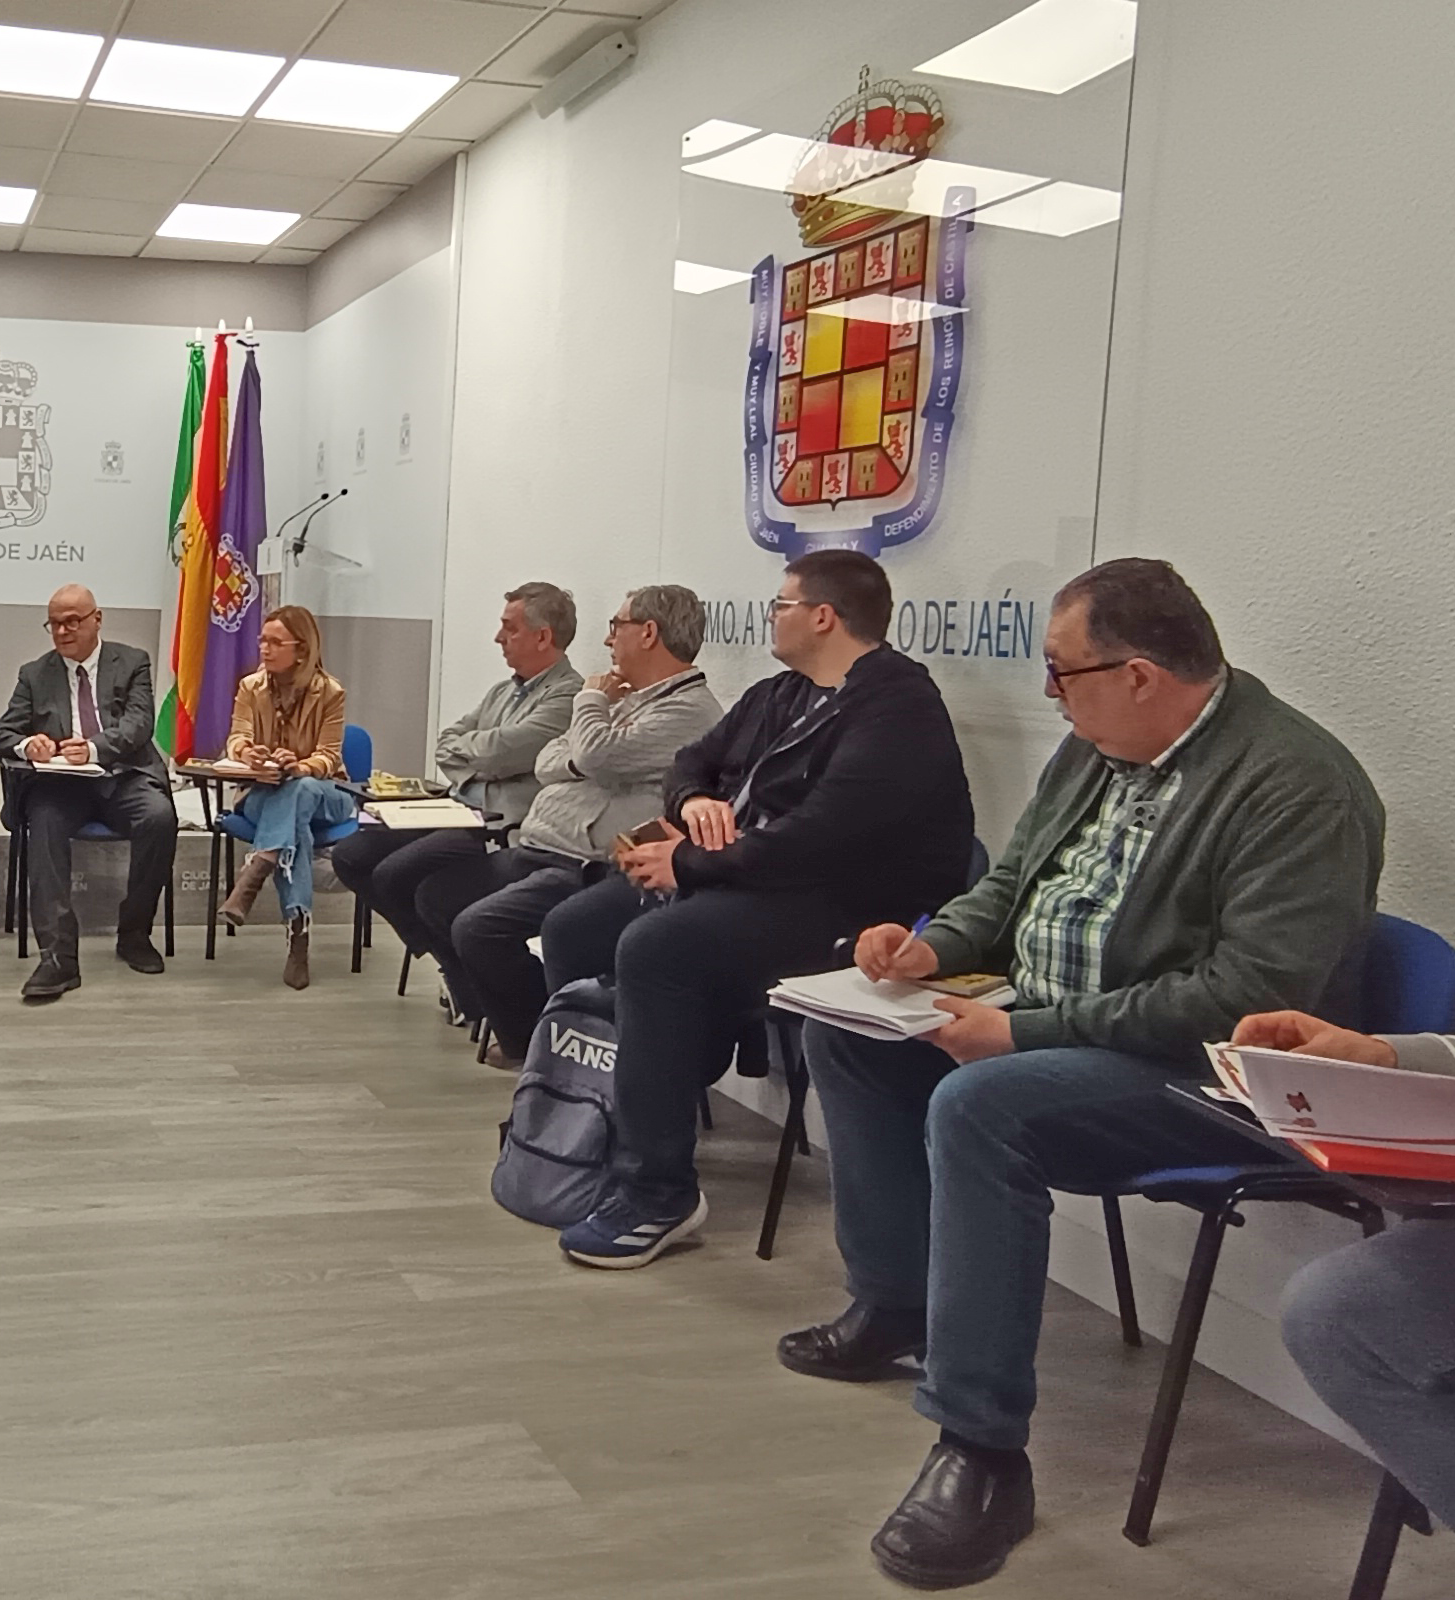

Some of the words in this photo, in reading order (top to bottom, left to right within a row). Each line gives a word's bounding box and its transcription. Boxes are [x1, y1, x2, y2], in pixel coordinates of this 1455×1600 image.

[761, 269, 769, 297] MUY
[754, 362, 763, 371] Y
[749, 375, 760, 404] MUY
[935, 376, 951, 407] LOS
[748, 408, 758, 441] LEAL
[932, 421, 944, 443] DE
[749, 452, 758, 502] CIUDAD
[758, 526, 780, 545] JAÉN
[26, 540, 85, 562] JAÉN
[923, 600, 957, 655] DE
[962, 588, 1034, 659] JAÉN
[182, 881, 196, 890] DE
[550, 1021, 618, 1073] VANS
